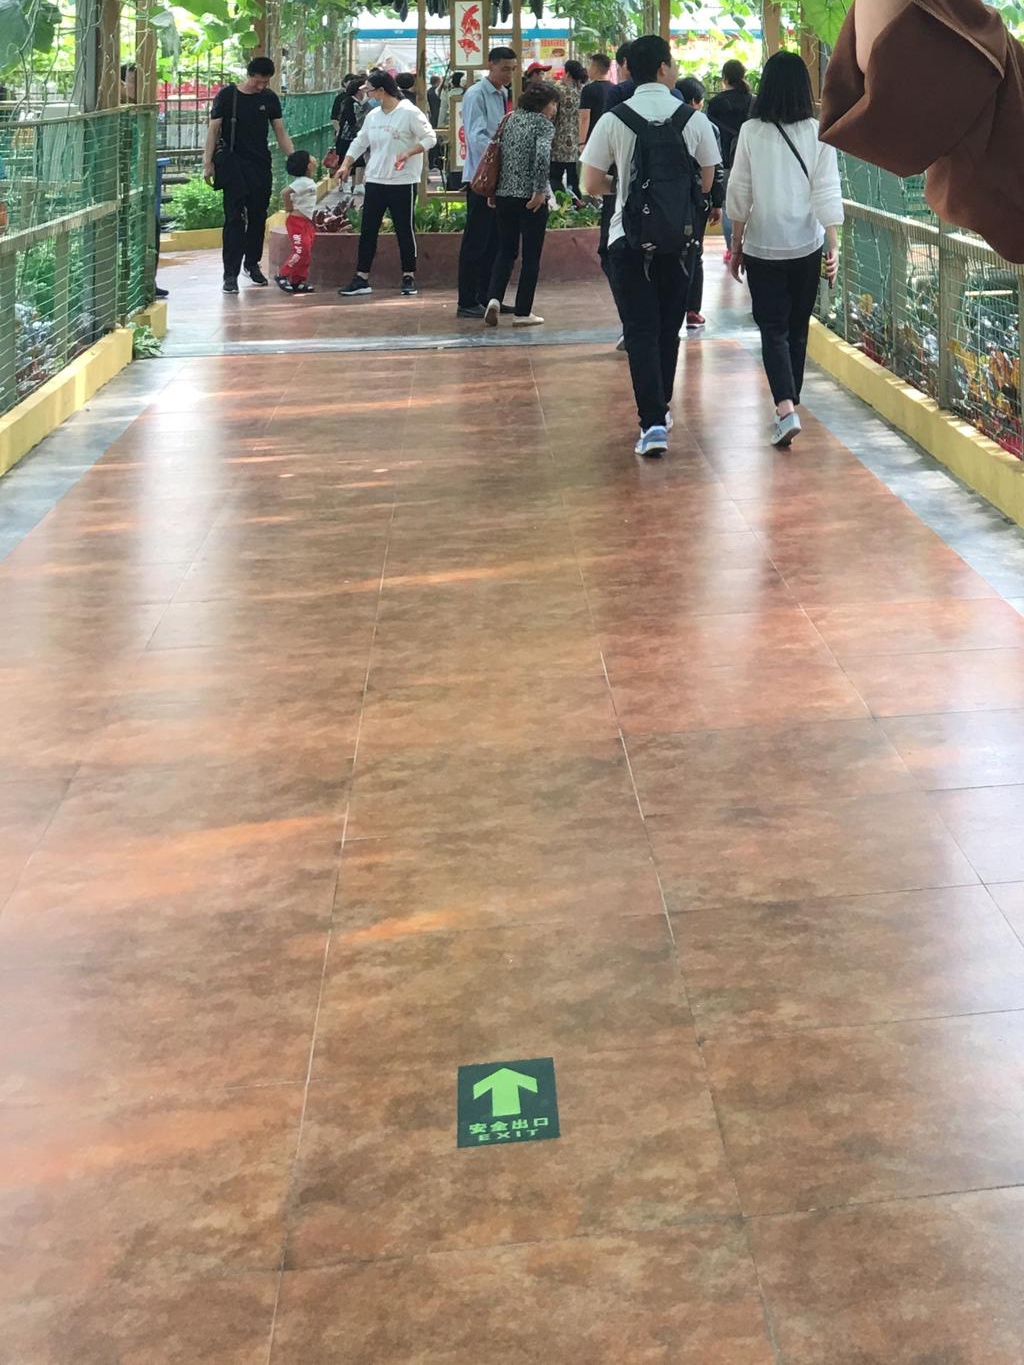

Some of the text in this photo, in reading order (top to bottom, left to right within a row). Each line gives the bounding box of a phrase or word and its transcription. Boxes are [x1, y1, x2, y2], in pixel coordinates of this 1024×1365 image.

[469, 1117, 549, 1134] 安全出口
[478, 1129, 539, 1141] EXIT
